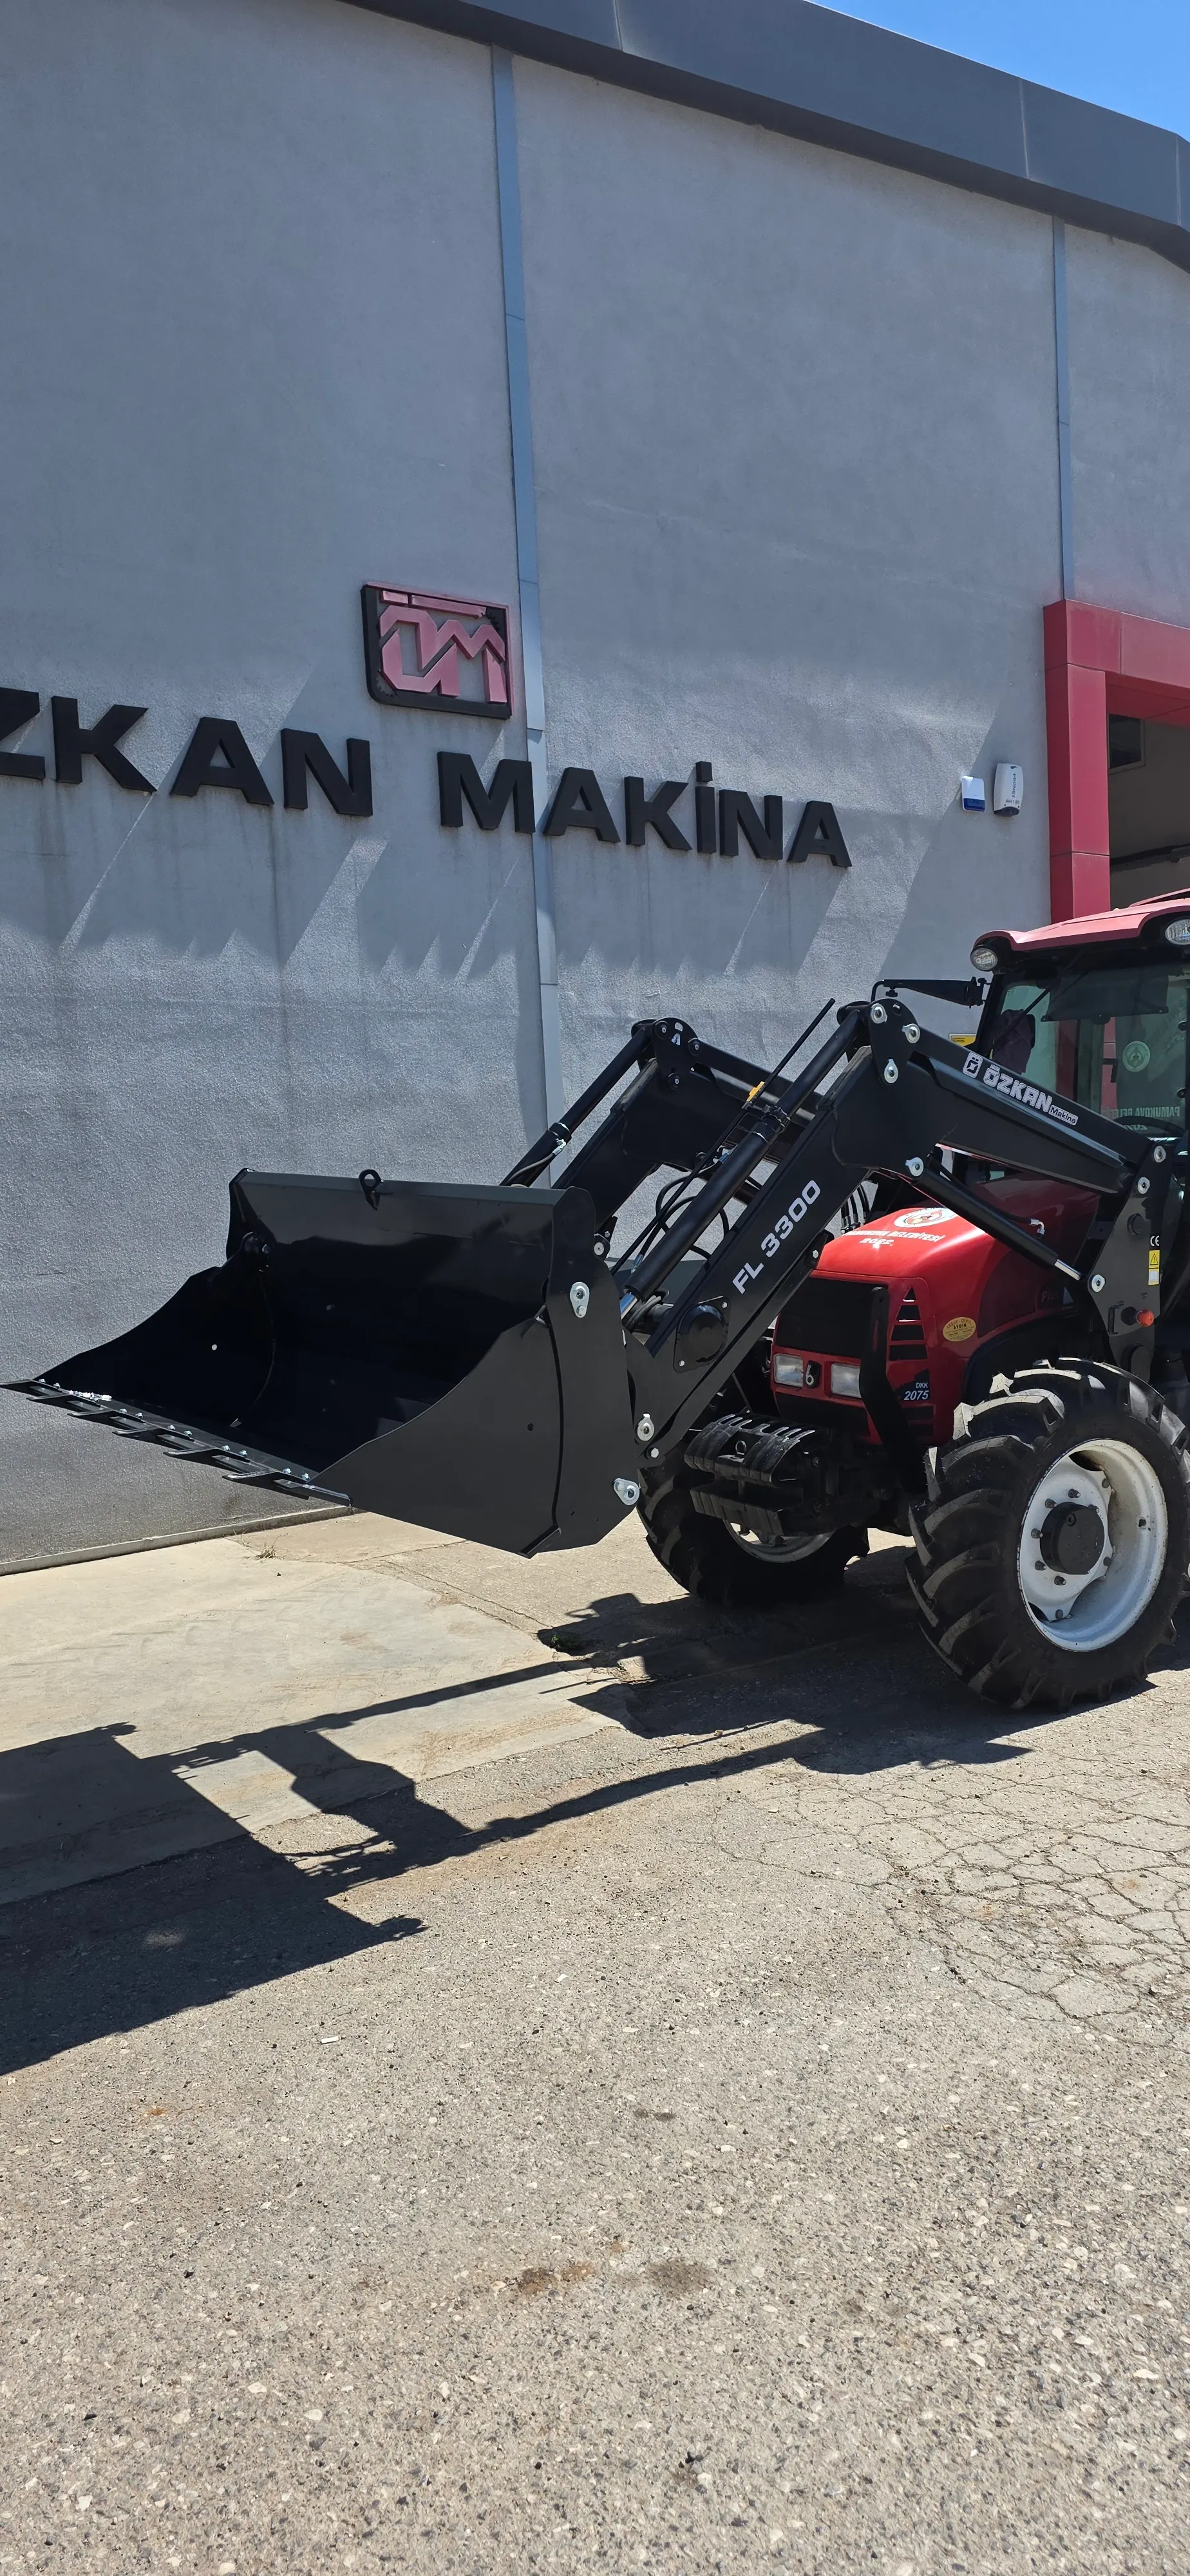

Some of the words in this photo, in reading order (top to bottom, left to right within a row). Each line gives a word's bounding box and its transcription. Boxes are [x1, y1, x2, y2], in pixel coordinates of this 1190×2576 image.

[437, 752, 852, 867] MAKİNA
[983, 1064, 1052, 1113] ÖZKAN
[1049, 1106, 1078, 1125] Makina
[732, 1262, 764, 1294] FL
[760, 1180, 821, 1258] 3300
[903, 1390, 929, 1401] 2075
